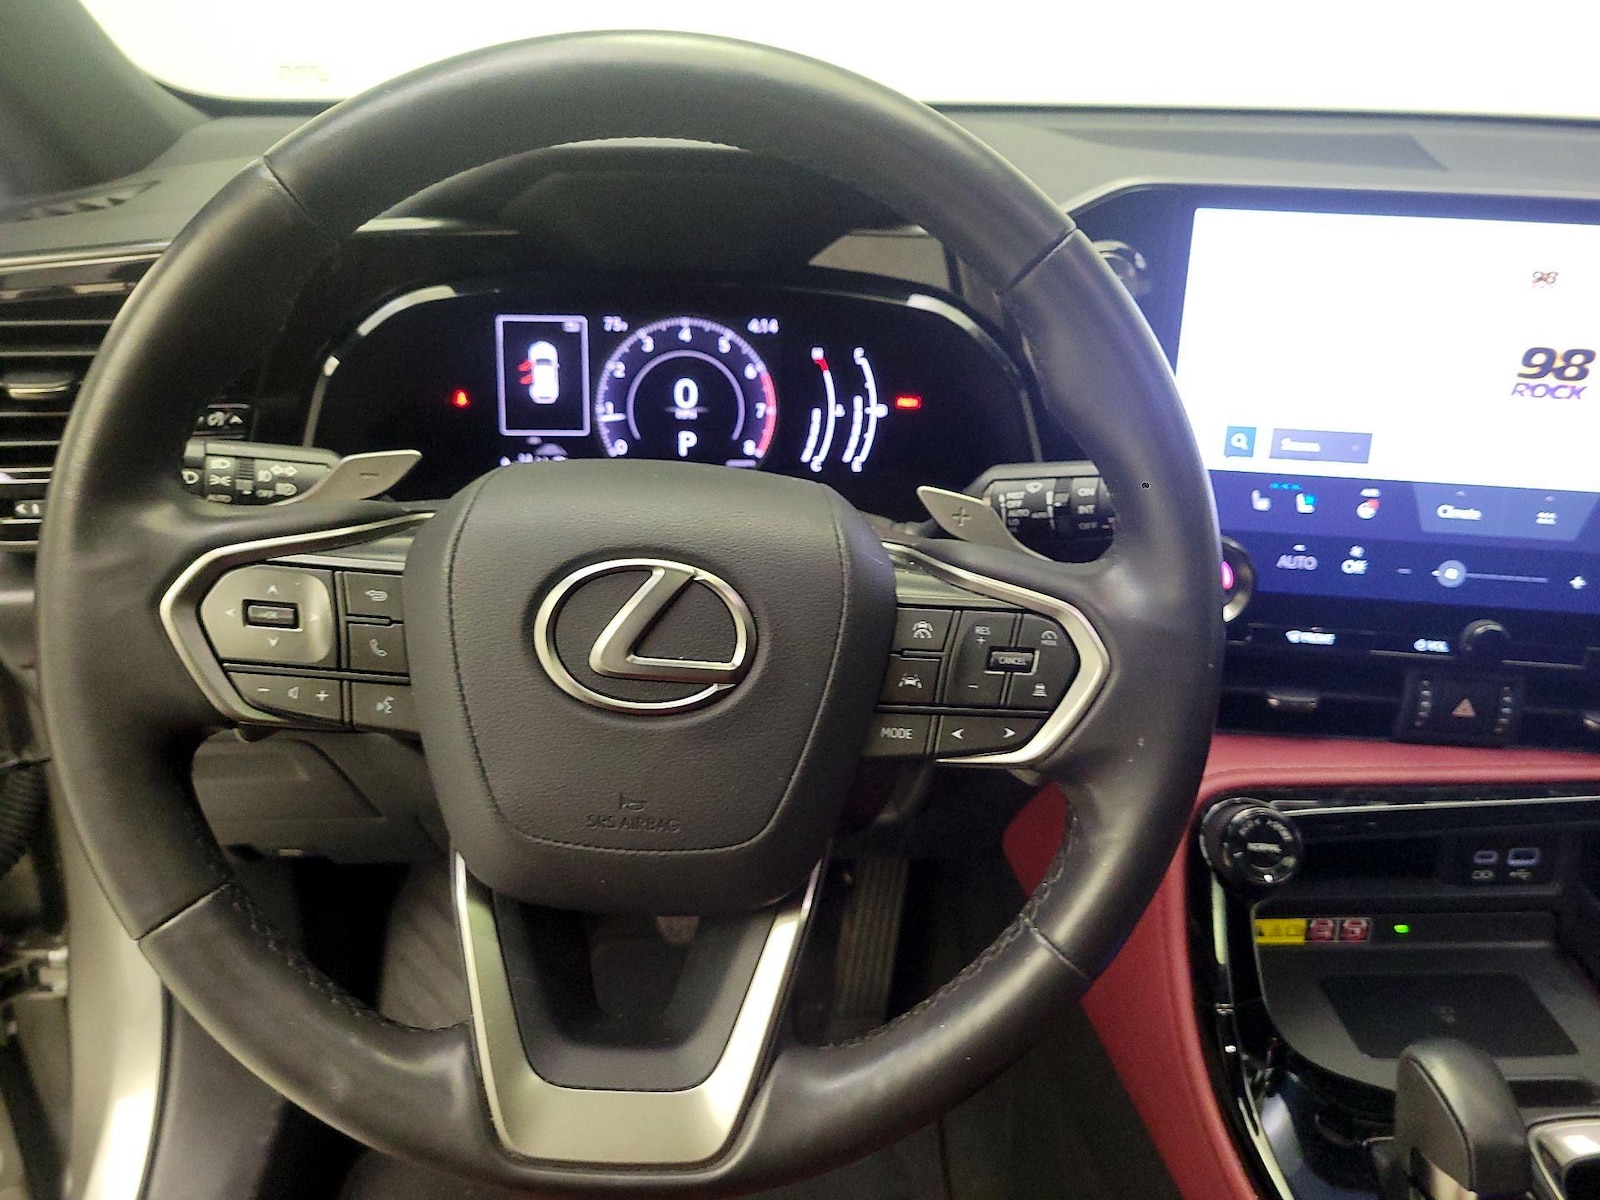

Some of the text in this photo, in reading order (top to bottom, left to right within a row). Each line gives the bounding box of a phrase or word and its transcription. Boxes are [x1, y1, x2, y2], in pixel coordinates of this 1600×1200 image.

[678, 327, 692, 342] 4
[1517, 347, 1597, 382] 98
[673, 377, 699, 409] 0
[1511, 382, 1588, 400] ROCK
[677, 430, 698, 457] P
[1276, 554, 1318, 571] AUTO
[975, 625, 991, 635] RES
[998, 656, 1027, 666] CANCEL
[880, 727, 913, 740] MODE
[620, 817, 680, 833] AIRBAG
